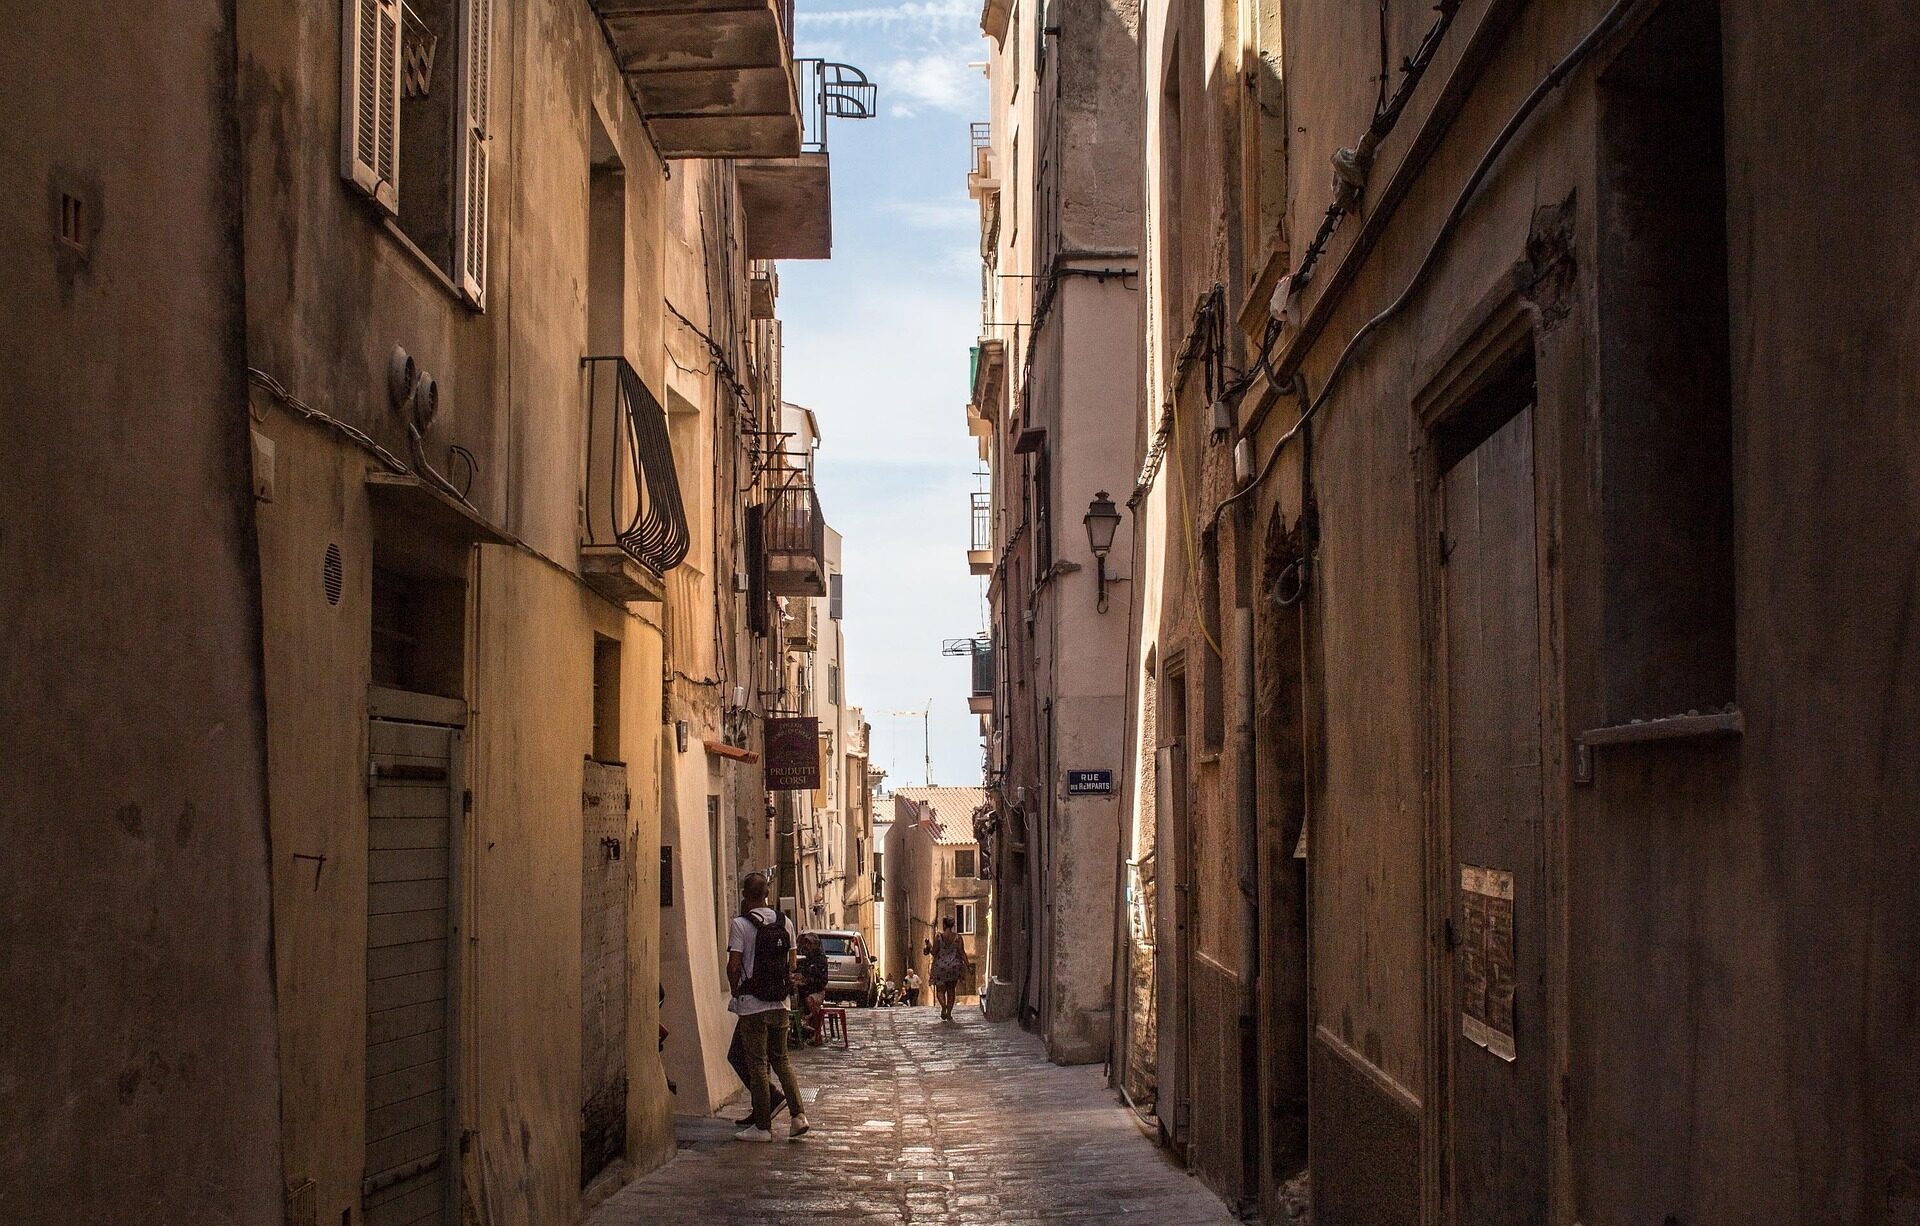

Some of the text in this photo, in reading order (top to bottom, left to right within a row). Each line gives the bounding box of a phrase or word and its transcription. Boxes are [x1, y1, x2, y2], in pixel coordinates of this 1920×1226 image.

[770, 766, 815, 776] PRUDUTTI
[779, 776, 806, 785] CORSI
[1081, 773, 1099, 781] RUE
